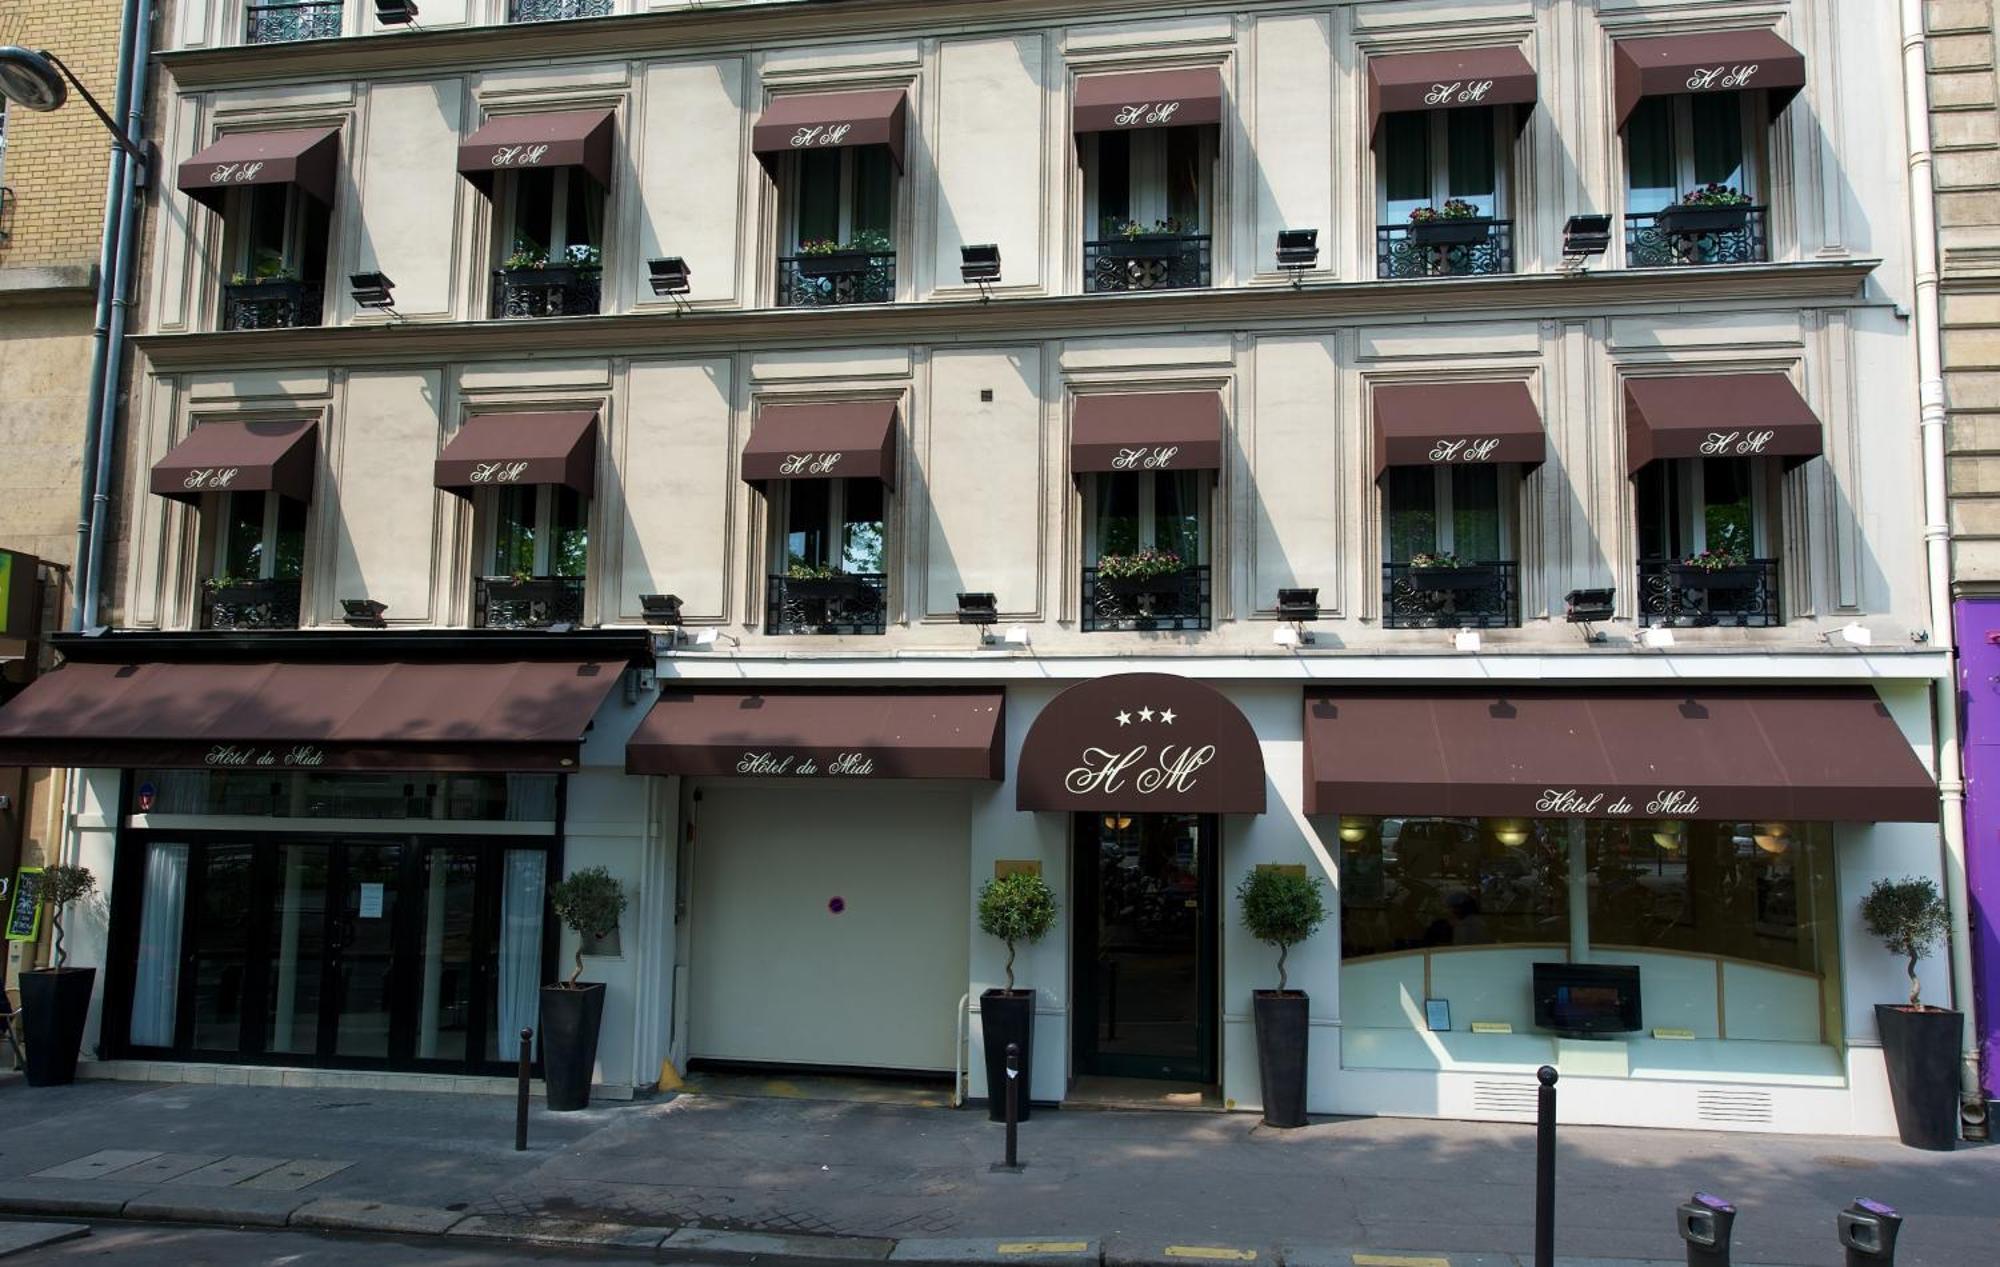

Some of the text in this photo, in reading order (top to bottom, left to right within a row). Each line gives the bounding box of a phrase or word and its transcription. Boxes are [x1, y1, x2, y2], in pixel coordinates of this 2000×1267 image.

[1685, 64, 1759, 90] H M
[1424, 80, 1493, 105] H M
[1113, 102, 1180, 126] H M
[790, 124, 852, 147] H M
[491, 144, 548, 166] H M
[210, 162, 264, 183] H M
[1428, 438, 1500, 462] H M
[1699, 430, 1775, 455] H M
[779, 452, 842, 475] H M
[1111, 446, 1179, 469] H M
[183, 467, 238, 489] H M
[469, 461, 528, 483] H M
[204, 745, 325, 766] Hôtel du Midi
[736, 752, 874, 775] Hôtel du Midi
[1064, 744, 1216, 795] H M
[1535, 788, 1700, 815] Hôtel du Midi
